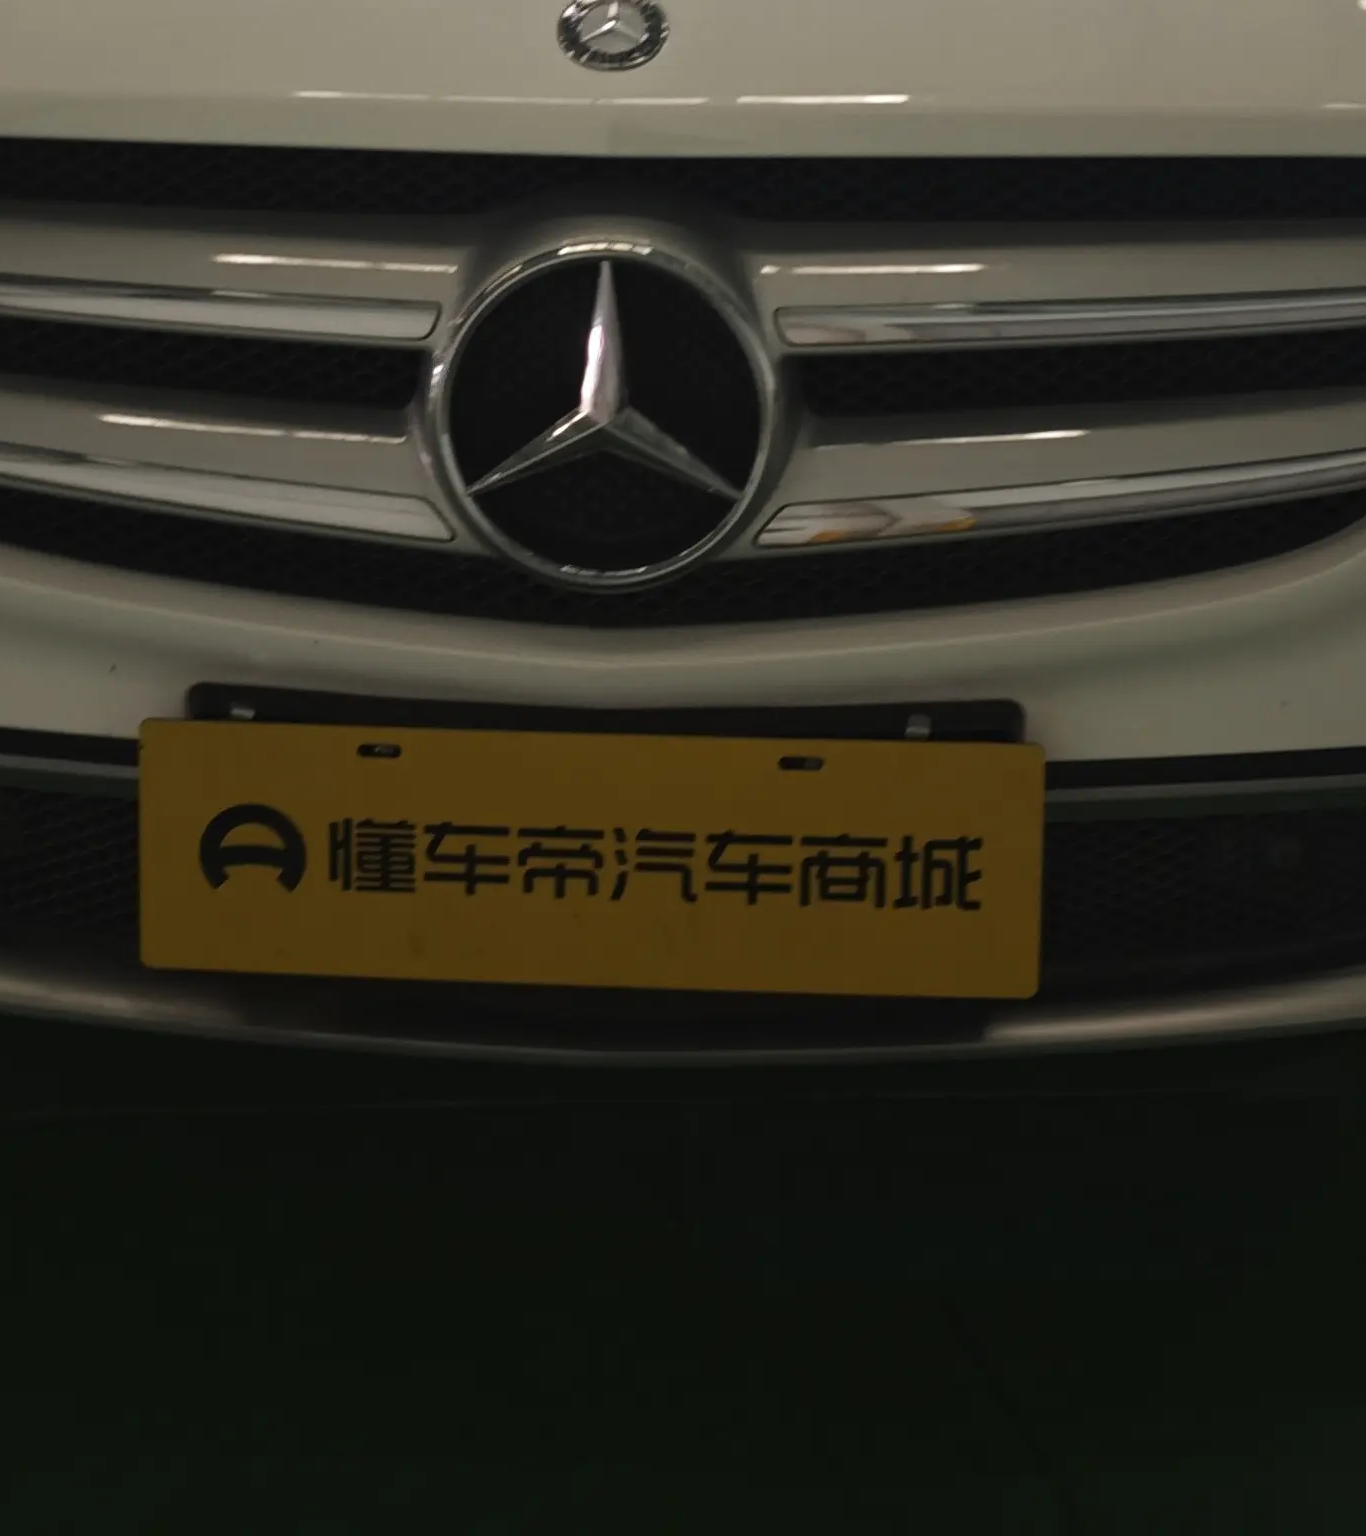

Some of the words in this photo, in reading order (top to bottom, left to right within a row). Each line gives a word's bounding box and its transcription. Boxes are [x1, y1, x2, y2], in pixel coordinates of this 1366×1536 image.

[329, 818, 982, 910] 懂车帝汽车商城
